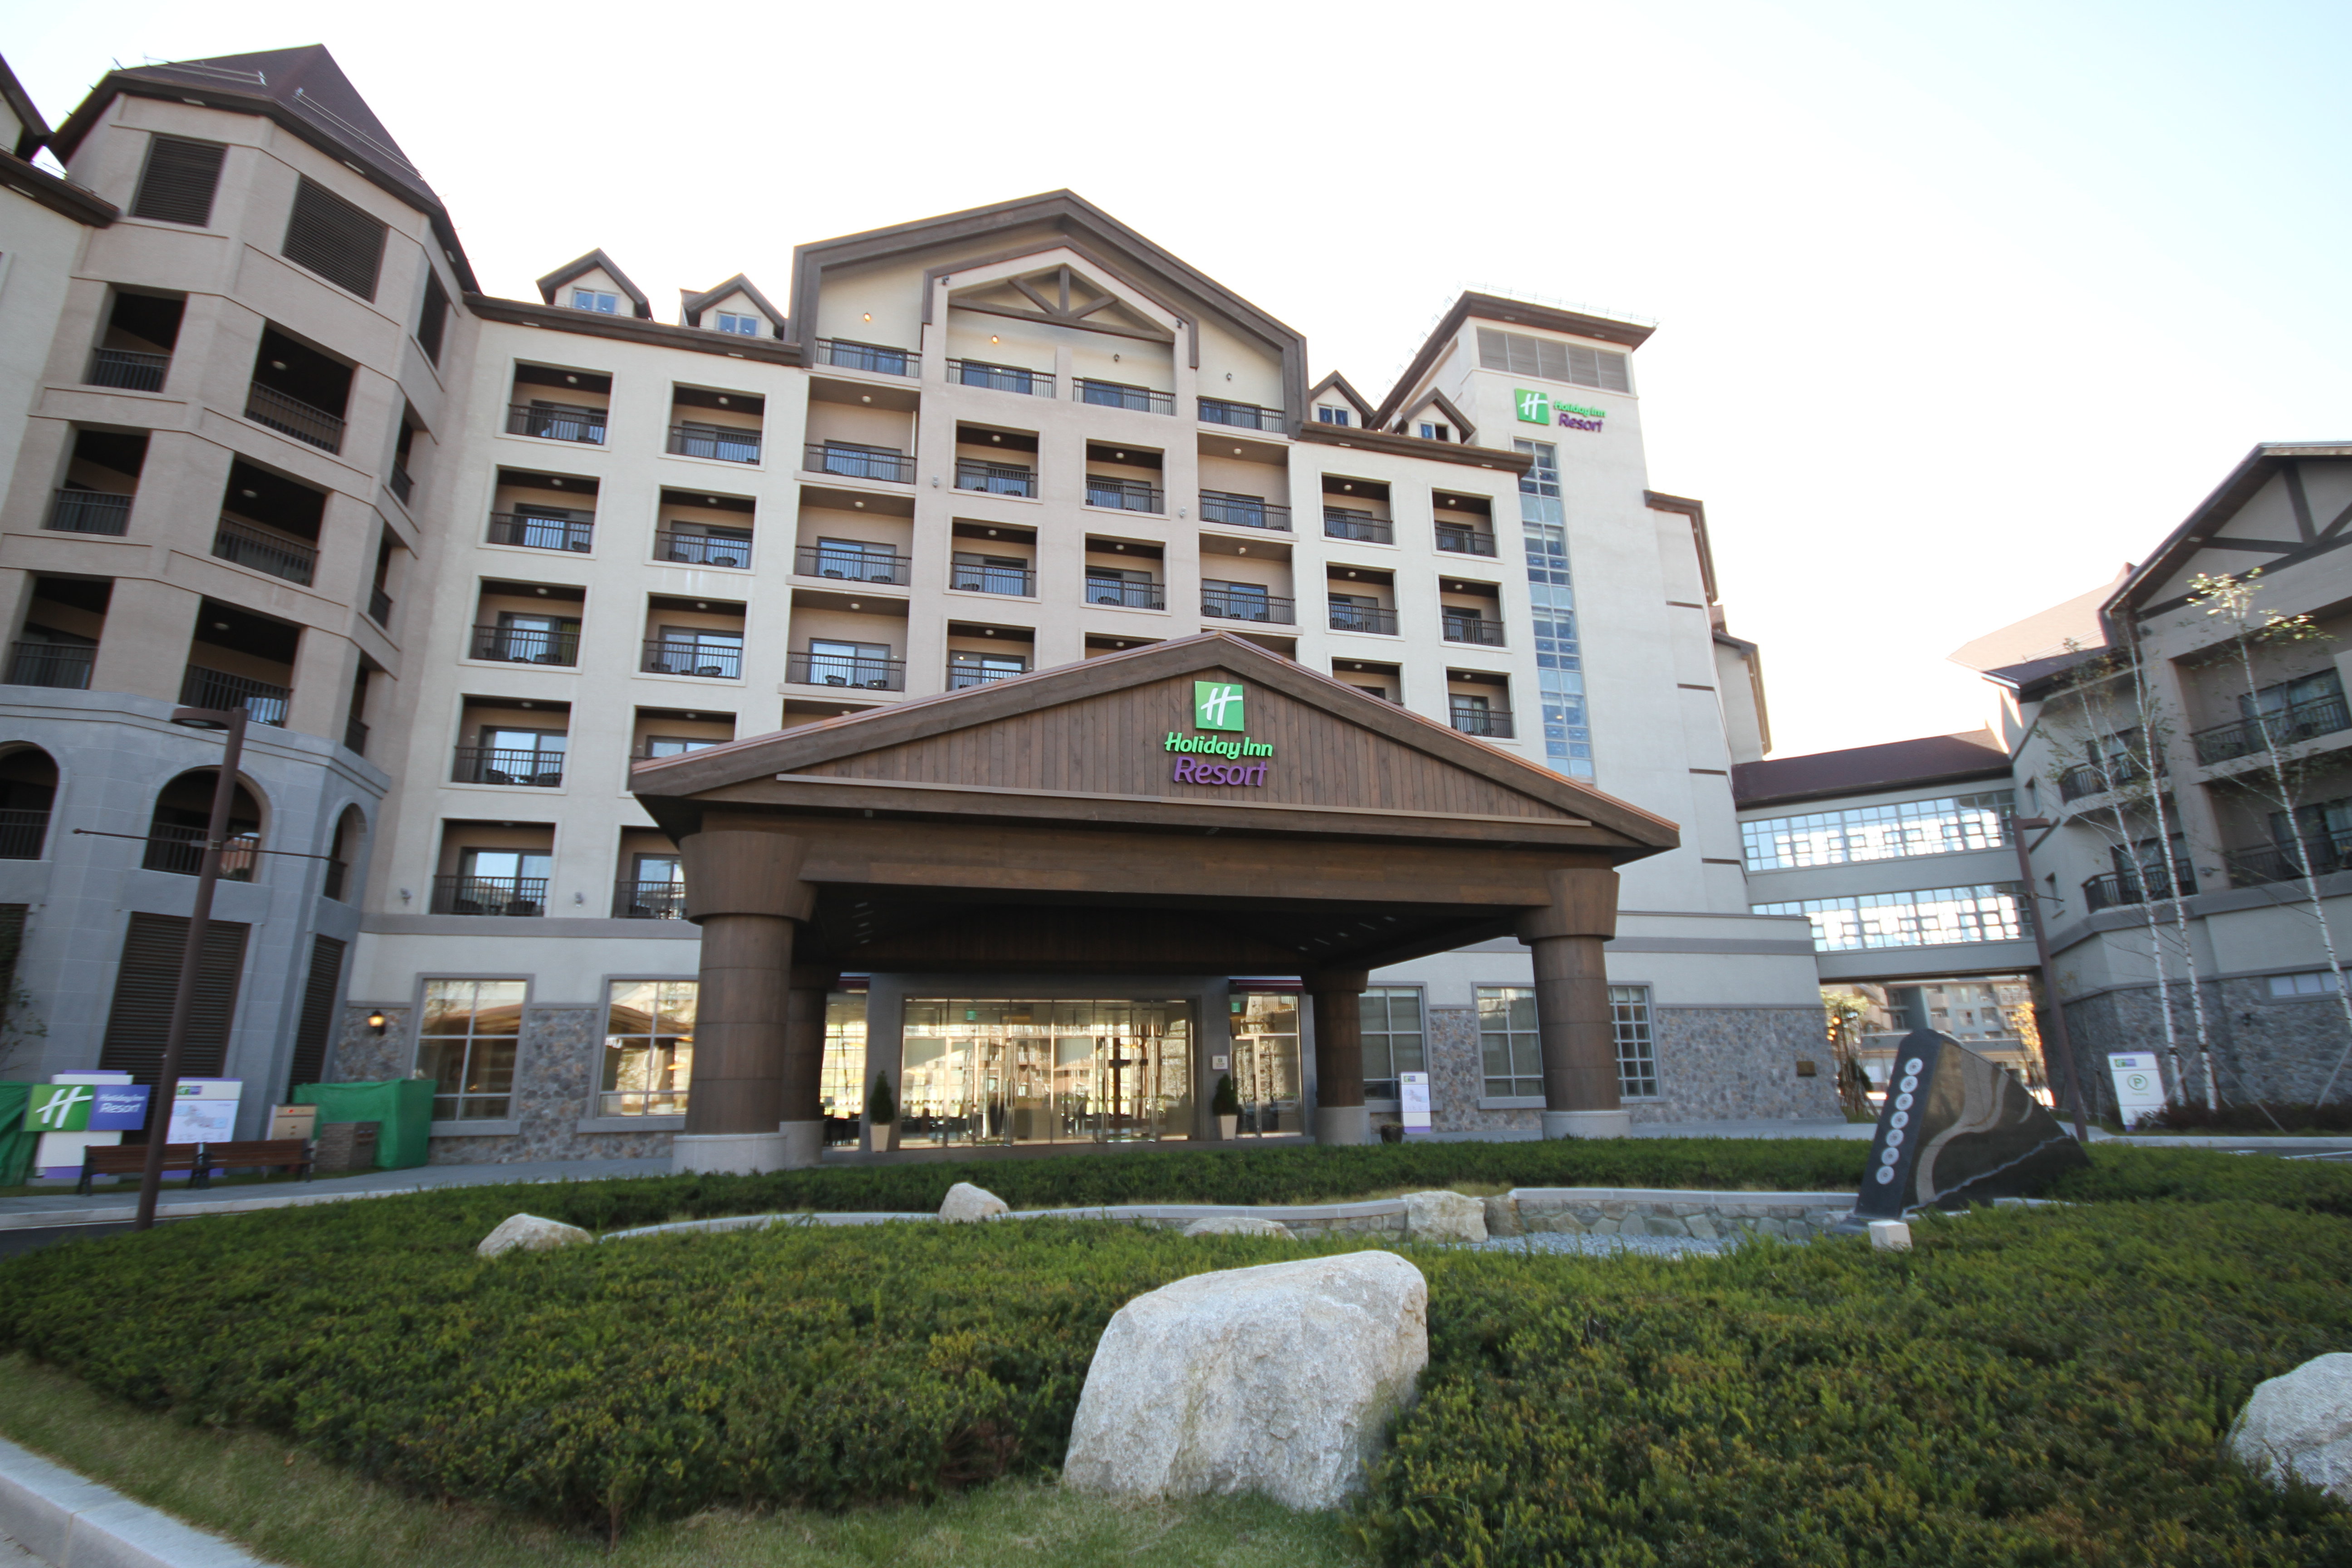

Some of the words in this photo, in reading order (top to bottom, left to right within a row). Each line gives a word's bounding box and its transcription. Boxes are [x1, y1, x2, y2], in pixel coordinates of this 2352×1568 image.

[1553, 400, 1590, 417] Holiday
[1590, 406, 1606, 417] Inn
[1558, 413, 1603, 433] Resort
[1165, 732, 1241, 760] Holiday
[1243, 737, 1273, 757] Inn
[1174, 756, 1268, 787] Resort
[2133, 1077, 2142, 1087] P
[98, 1093, 131, 1103] Holiday
[99, 1102, 142, 1113] Resort
